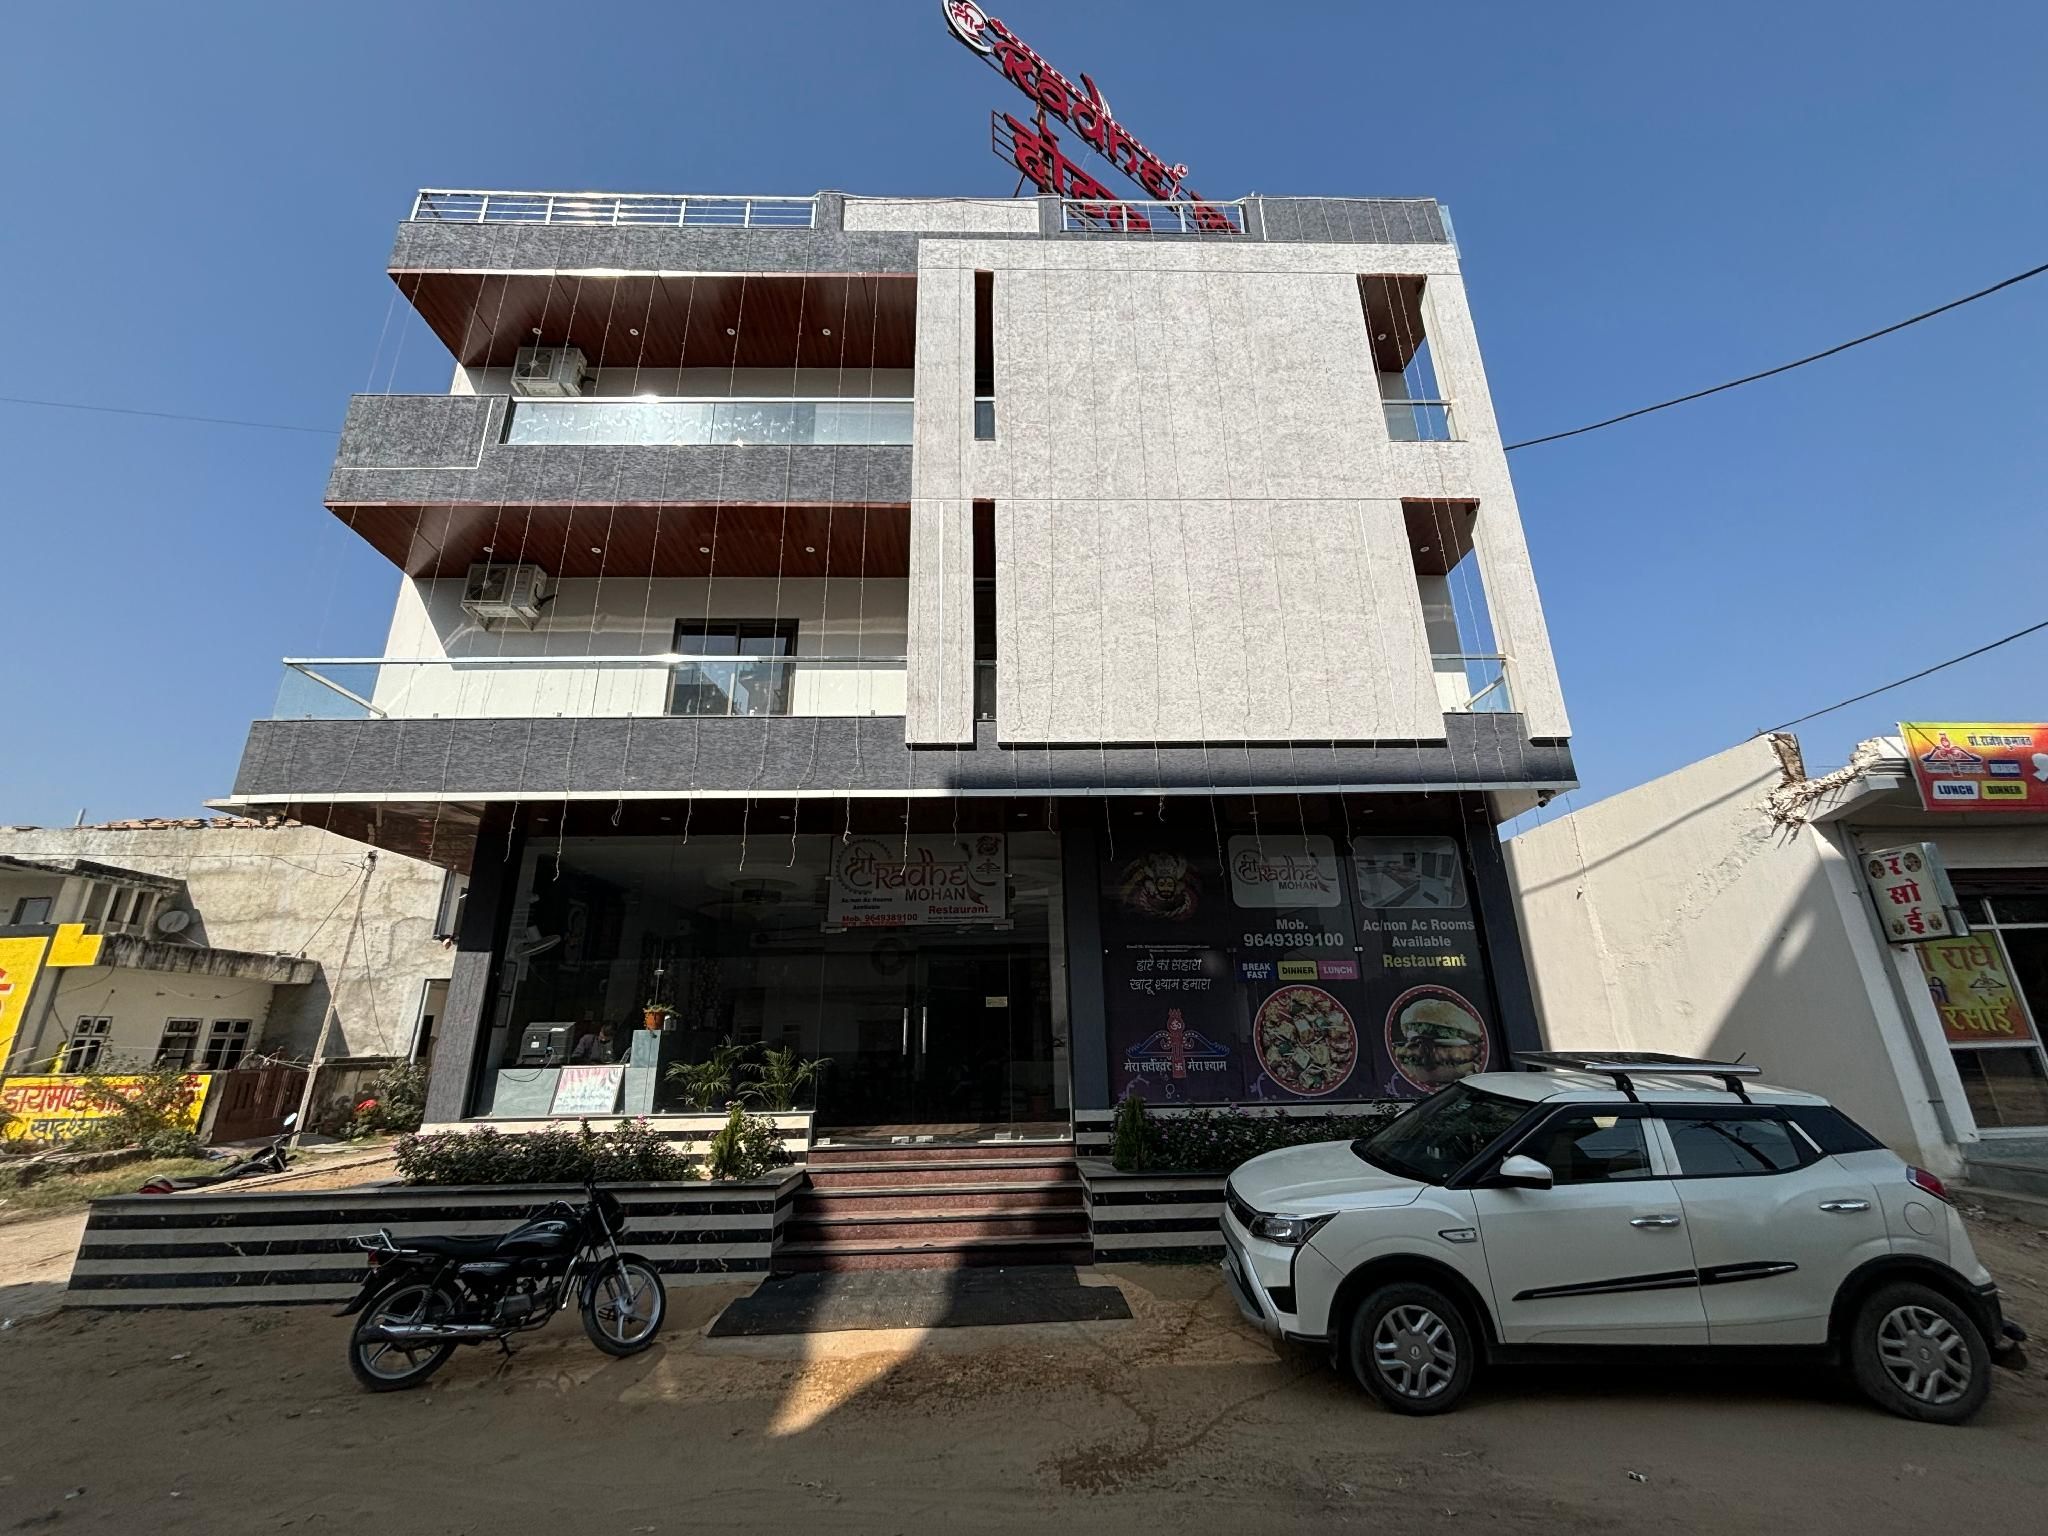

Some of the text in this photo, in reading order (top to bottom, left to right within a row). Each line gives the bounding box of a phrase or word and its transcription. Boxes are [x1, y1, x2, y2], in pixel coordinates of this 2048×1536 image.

[1937, 784, 1975, 796] LUNCH
[875, 848, 967, 889] Radhe
[1278, 881, 1318, 890] MOHAN
[905, 887, 966, 902] MOHAN
[928, 904, 989, 915] Restaurant
[865, 912, 918, 922] 9649389100
[1275, 918, 1309, 930] Mob.
[1411, 918, 1428, 931] Ac
[1430, 918, 1475, 931] Rooms
[1243, 932, 1344, 947] 9649389100
[1391, 935, 1452, 948] Available
[1241, 962, 1271, 971] BREAK
[1382, 953, 1468, 968] Restaurant
[1246, 971, 1268, 979] FAST
[1281, 966, 1314, 975] DINNER
[1323, 965, 1353, 975] LUNCH
